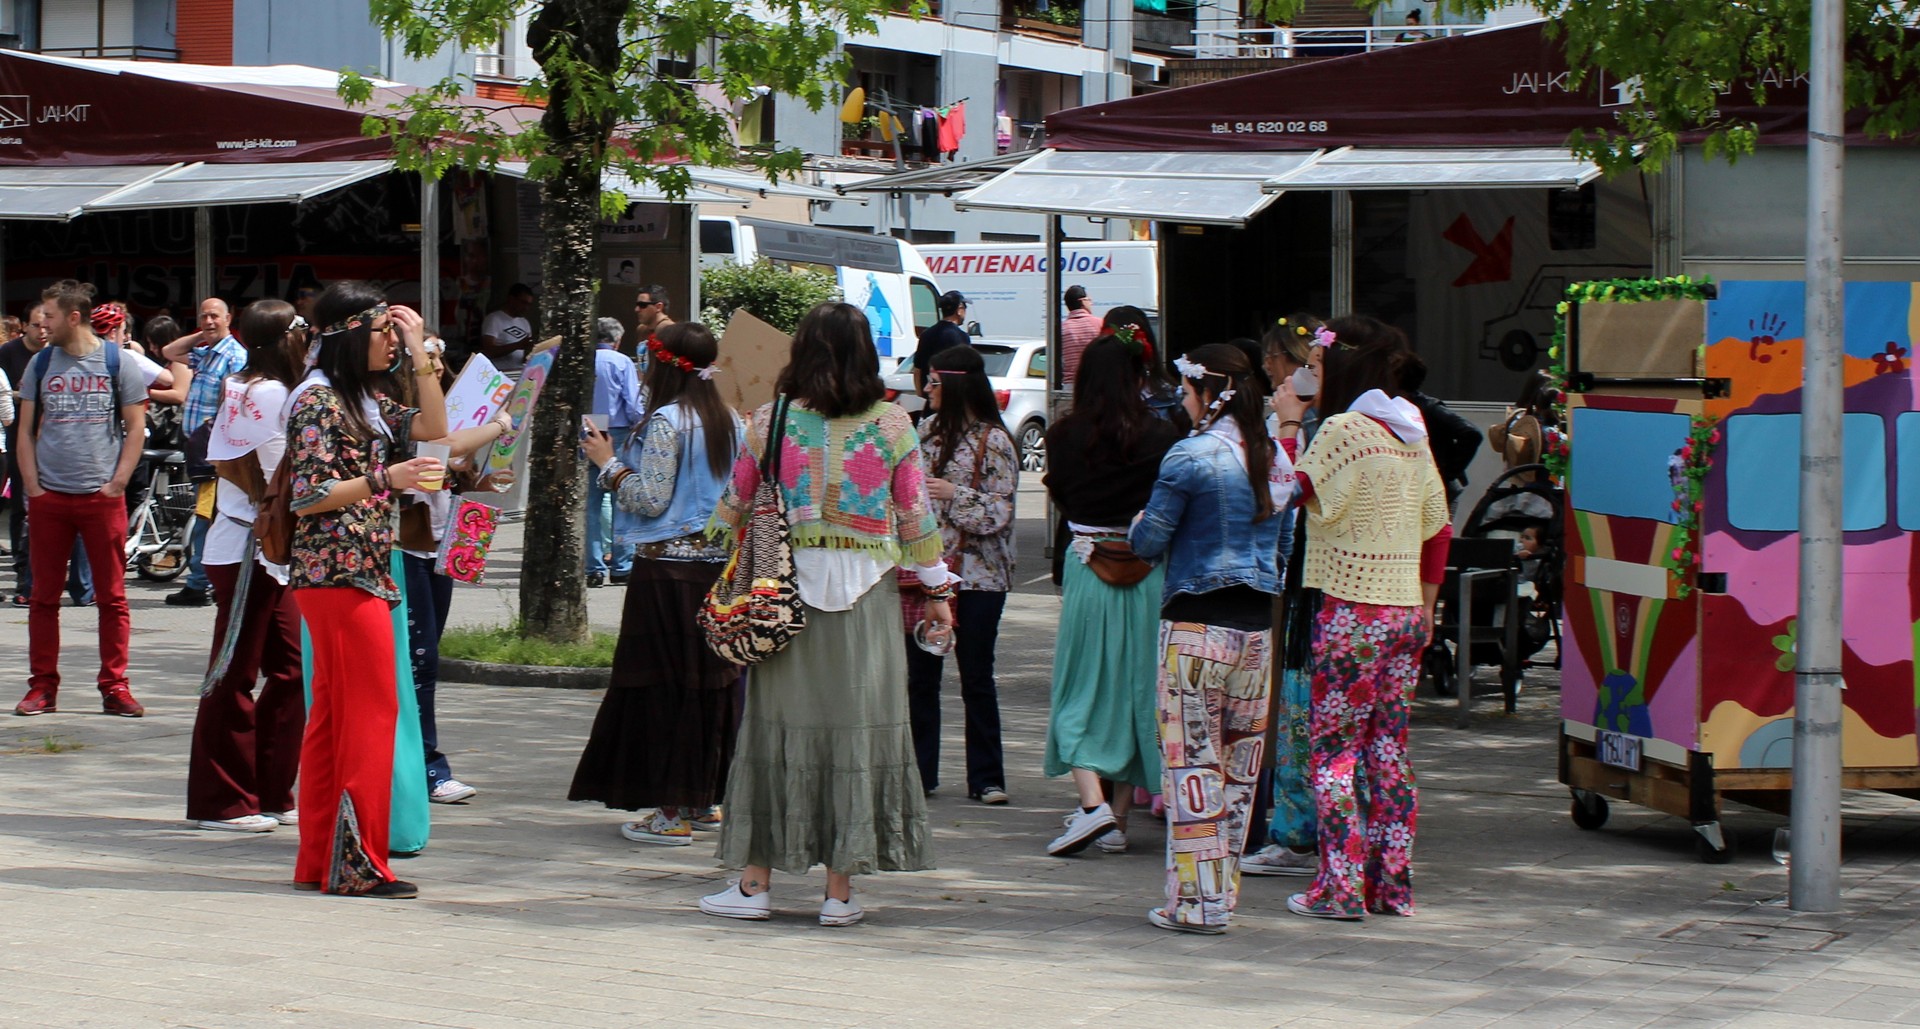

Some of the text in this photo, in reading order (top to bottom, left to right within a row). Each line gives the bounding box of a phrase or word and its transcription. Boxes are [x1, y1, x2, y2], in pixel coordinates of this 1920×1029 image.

[1502, 71, 1580, 95] JAI-KI
[36, 104, 91, 123] JAI-KIT
[1211, 120, 1328, 134] tel. 94 620 02 68
[216, 138, 297, 151] www.jai-kit.com
[75, 262, 324, 311] USTZIA
[47, 375, 110, 393] QUIK
[47, 393, 112, 412] SILVER
